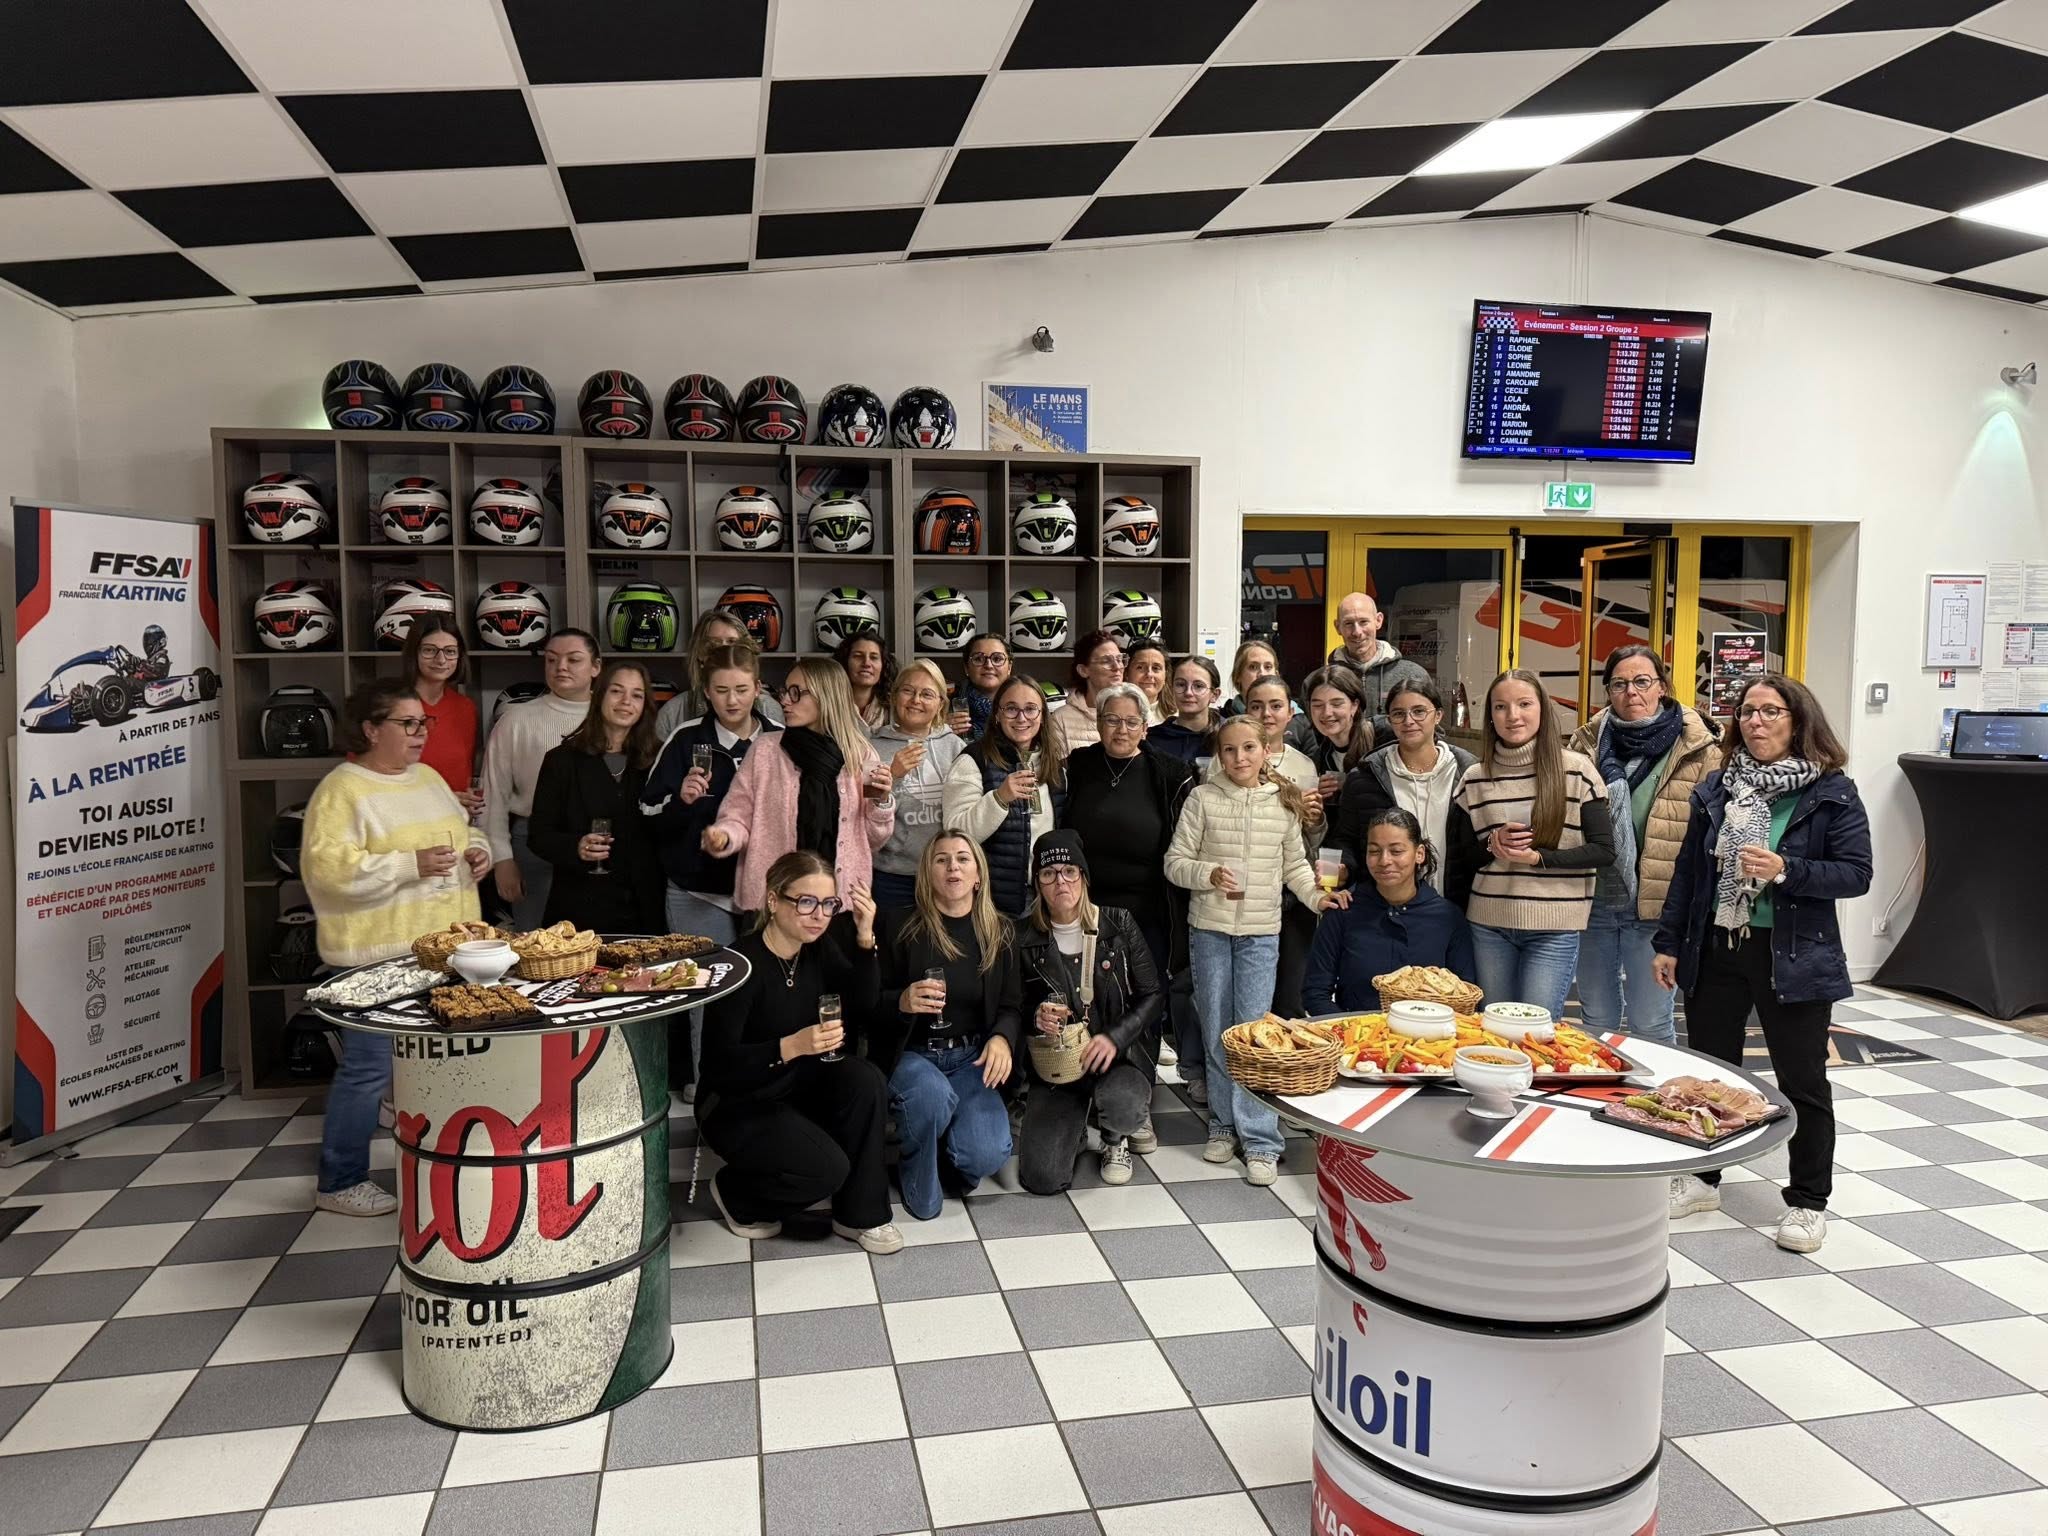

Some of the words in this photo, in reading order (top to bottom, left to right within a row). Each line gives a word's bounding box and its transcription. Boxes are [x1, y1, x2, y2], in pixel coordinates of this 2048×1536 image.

[1569, 323, 1598, 331] Session
[1605, 325, 1631, 333] Groupe
[1509, 336, 1540, 344] RAPHAEL
[1505, 378, 1538, 386] CAROLINE
[1033, 393, 1047, 403] LE
[1049, 394, 1082, 404] MANS
[1503, 402, 1530, 411] ANDRÉA
[90, 552, 180, 578] FFSA
[59, 590, 100, 600] FRANÇAISE
[80, 582, 102, 591] ÉCOLE
[101, 584, 186, 602] KARTING
[188, 677, 195, 693] 5
[118, 728, 128, 743] À
[130, 722, 170, 741] PARTIR
[172, 719, 187, 732] DE
[189, 716, 195, 727] 7
[198, 710, 220, 725] ANS
[28, 778, 46, 803] À
[52, 773, 83, 798] LA
[90, 745, 187, 787] RENTRÉE
[79, 806, 112, 824] TOI
[119, 797, 173, 820] AUSSI
[39, 830, 128, 858] DEVIENS
[134, 821, 196, 843] PILOTE
[28, 864, 71, 881] REJOINS
[73, 857, 112, 874] L'ÉCOLE
[114, 850, 163, 869] FRANÇAISE
[165, 847, 177, 857] DE
[179, 841, 214, 855] KARTING
[27, 888, 85, 907] BÉNÉFICIE
[87, 882, 112, 897] D'UN
[115, 872, 177, 893] PROGRAMME
[180, 863, 215, 878] ADAPTÉ
[38, 909, 52, 920] ET
[55, 895, 106, 917] ENCADRÉ
[109, 894, 129, 906] PAR
[131, 889, 150, 901] DES
[152, 878, 206, 897] MONITEURS
[102, 901, 152, 920] DIPLÔMÉS
[125, 935, 183, 956] ROUTE/CIRCUIT
[125, 958, 156, 973] ATELIER
[125, 964, 169, 983] MÉCANIQUE
[124, 988, 160, 1005] PILOTAGE
[124, 1010, 160, 1029] SÉCURITÉ
[106, 1047, 128, 1062] LISTE
[131, 1044, 143, 1056] DES
[61, 1071, 91, 1087] ÉCOLES
[94, 1056, 141, 1078] FRANÇAISES
[144, 1051, 153, 1061] DE
[154, 1039, 186, 1055] KARTING
[69, 1063, 178, 1107] WWW.FFSA-EFK.COM
[467, 1299, 528, 1326] OIL
[422, 1328, 531, 1349] (PATENTED)
